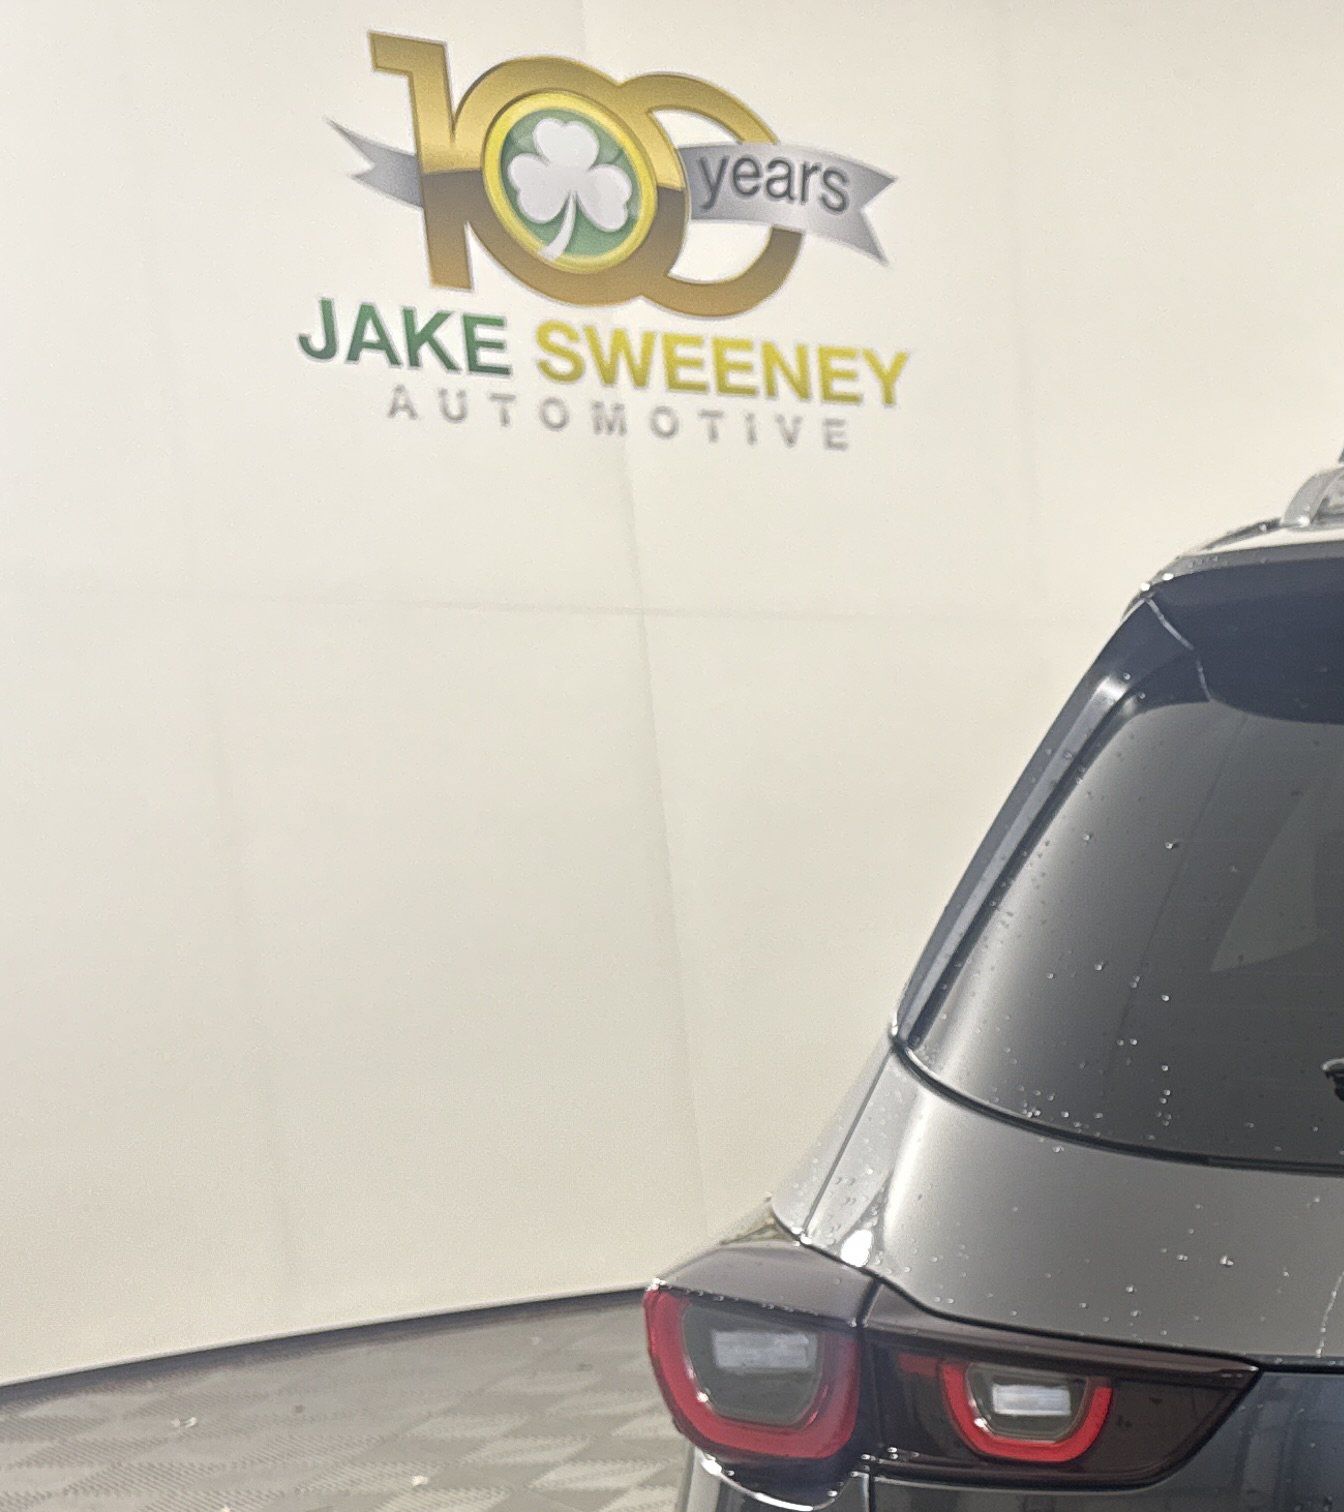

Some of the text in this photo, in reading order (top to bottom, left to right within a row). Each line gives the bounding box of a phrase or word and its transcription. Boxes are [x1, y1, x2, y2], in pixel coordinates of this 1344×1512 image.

[696, 153, 851, 214] years
[298, 296, 912, 406] JAKE SWEENEY
[387, 384, 849, 452] AUTOMOTIVE
